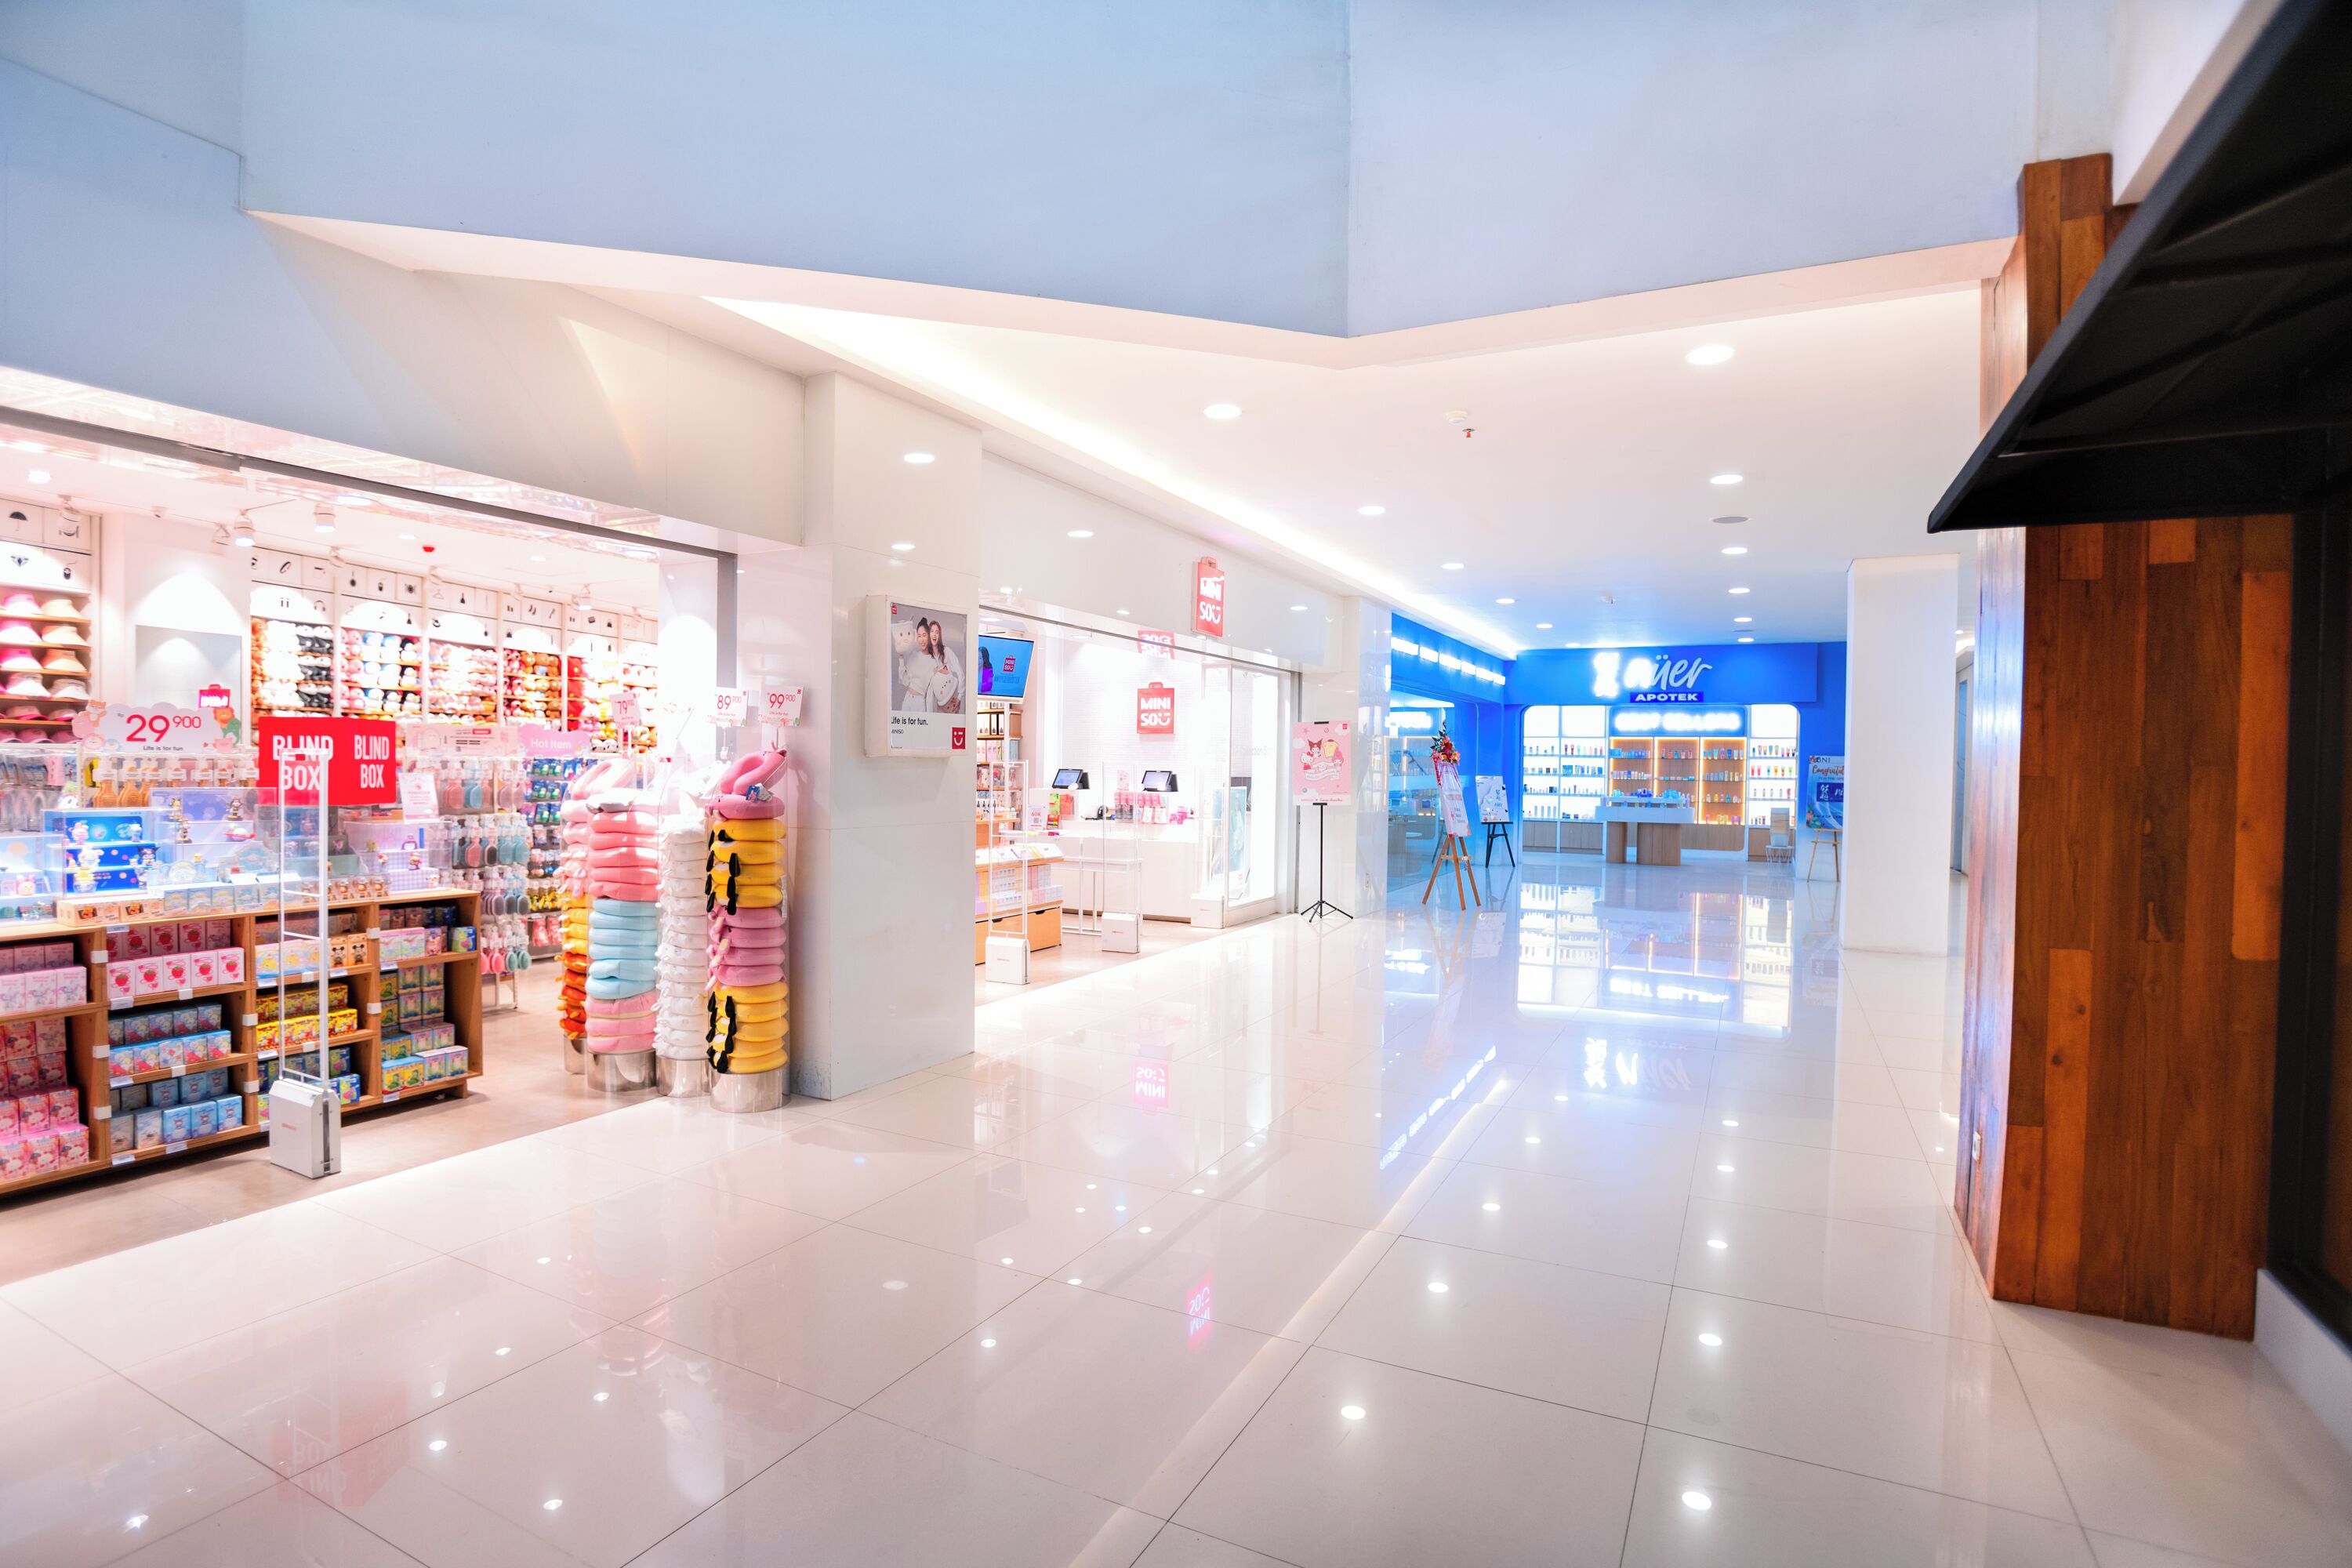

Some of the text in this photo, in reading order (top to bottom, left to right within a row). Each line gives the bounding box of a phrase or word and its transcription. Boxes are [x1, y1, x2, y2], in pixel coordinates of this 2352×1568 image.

[1624, 655, 1713, 691] üer
[1140, 697, 1171, 710] MINI
[1635, 693, 1699, 702] APOTEK
[917, 717, 928, 726] fun.
[272, 735, 333, 761] BLIND
[354, 735, 390, 760] BLIND
[530, 739, 572, 750] Hot Item
[282, 765, 321, 790] BOX
[360, 764, 385, 789] BOX
